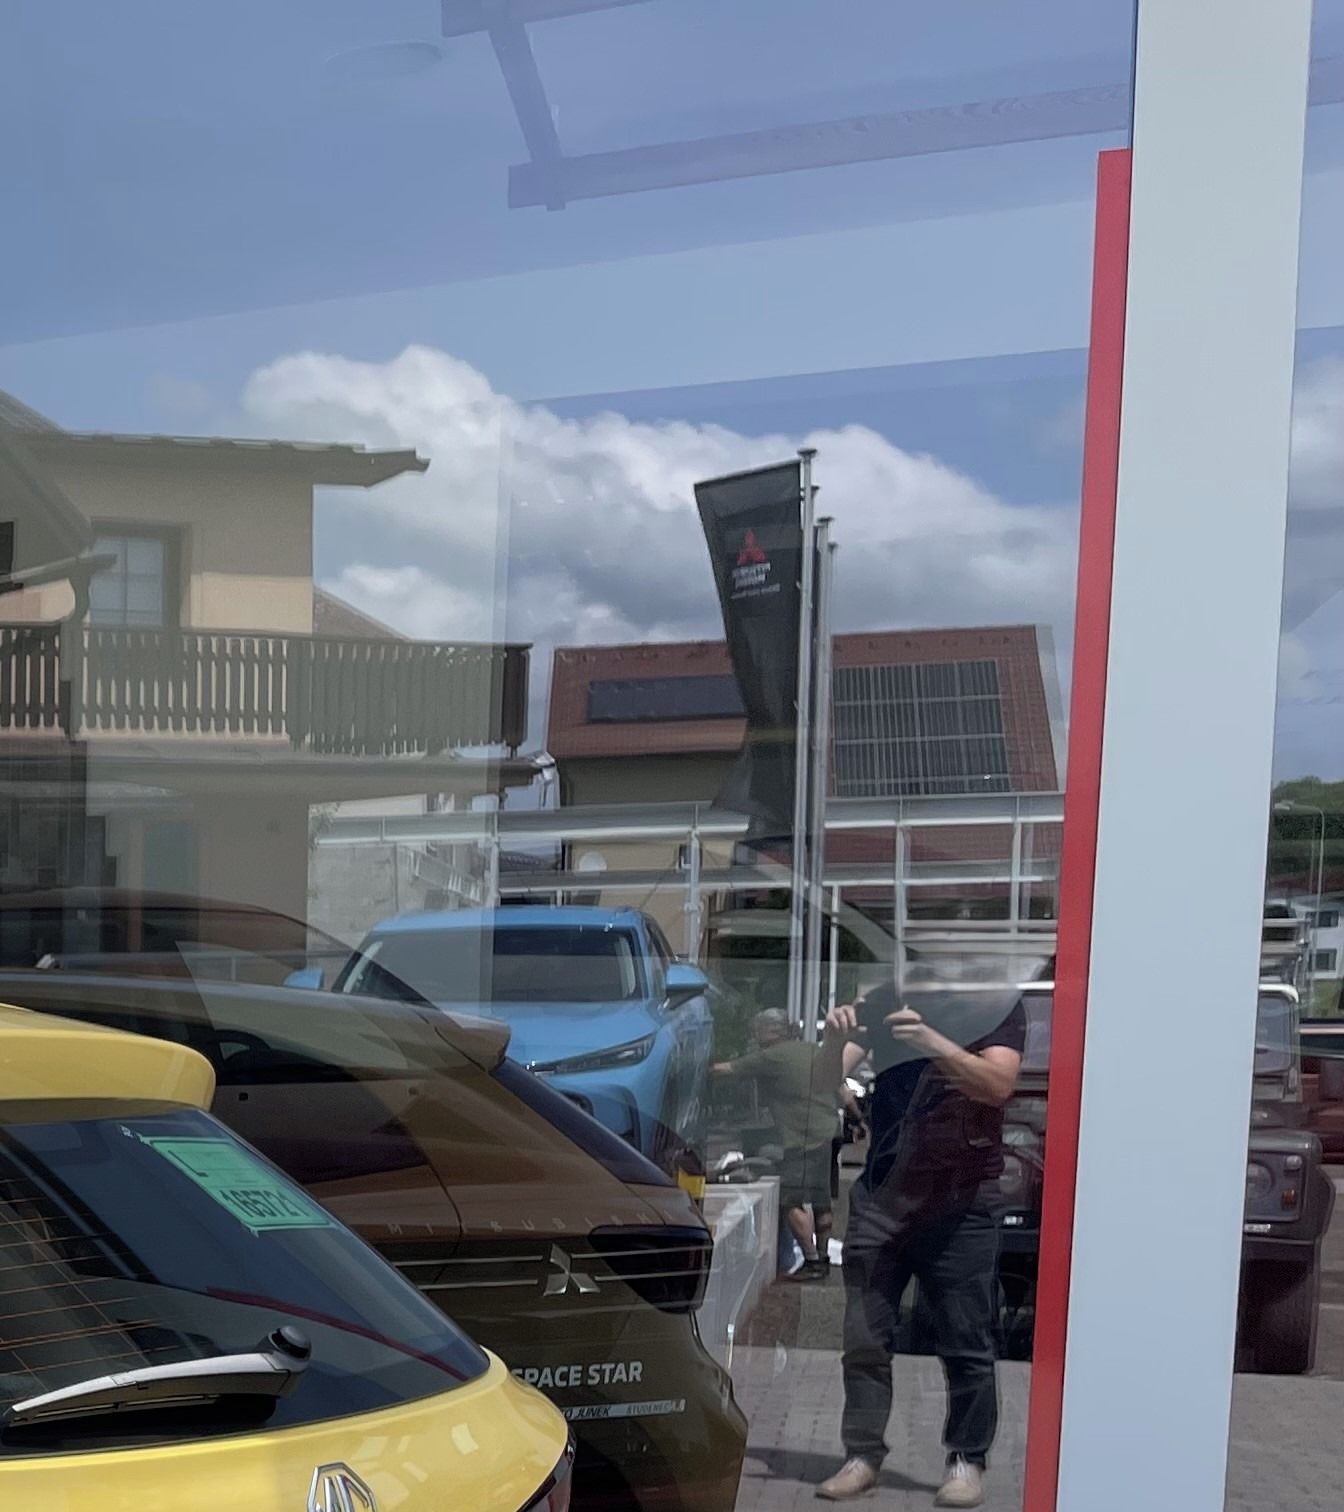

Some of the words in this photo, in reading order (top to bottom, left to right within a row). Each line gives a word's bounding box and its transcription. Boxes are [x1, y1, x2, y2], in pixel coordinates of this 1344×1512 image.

[511, 1364, 583, 1388] SPACE
[587, 1361, 643, 1385] STAR
[576, 1405, 611, 1418] JUNEK
